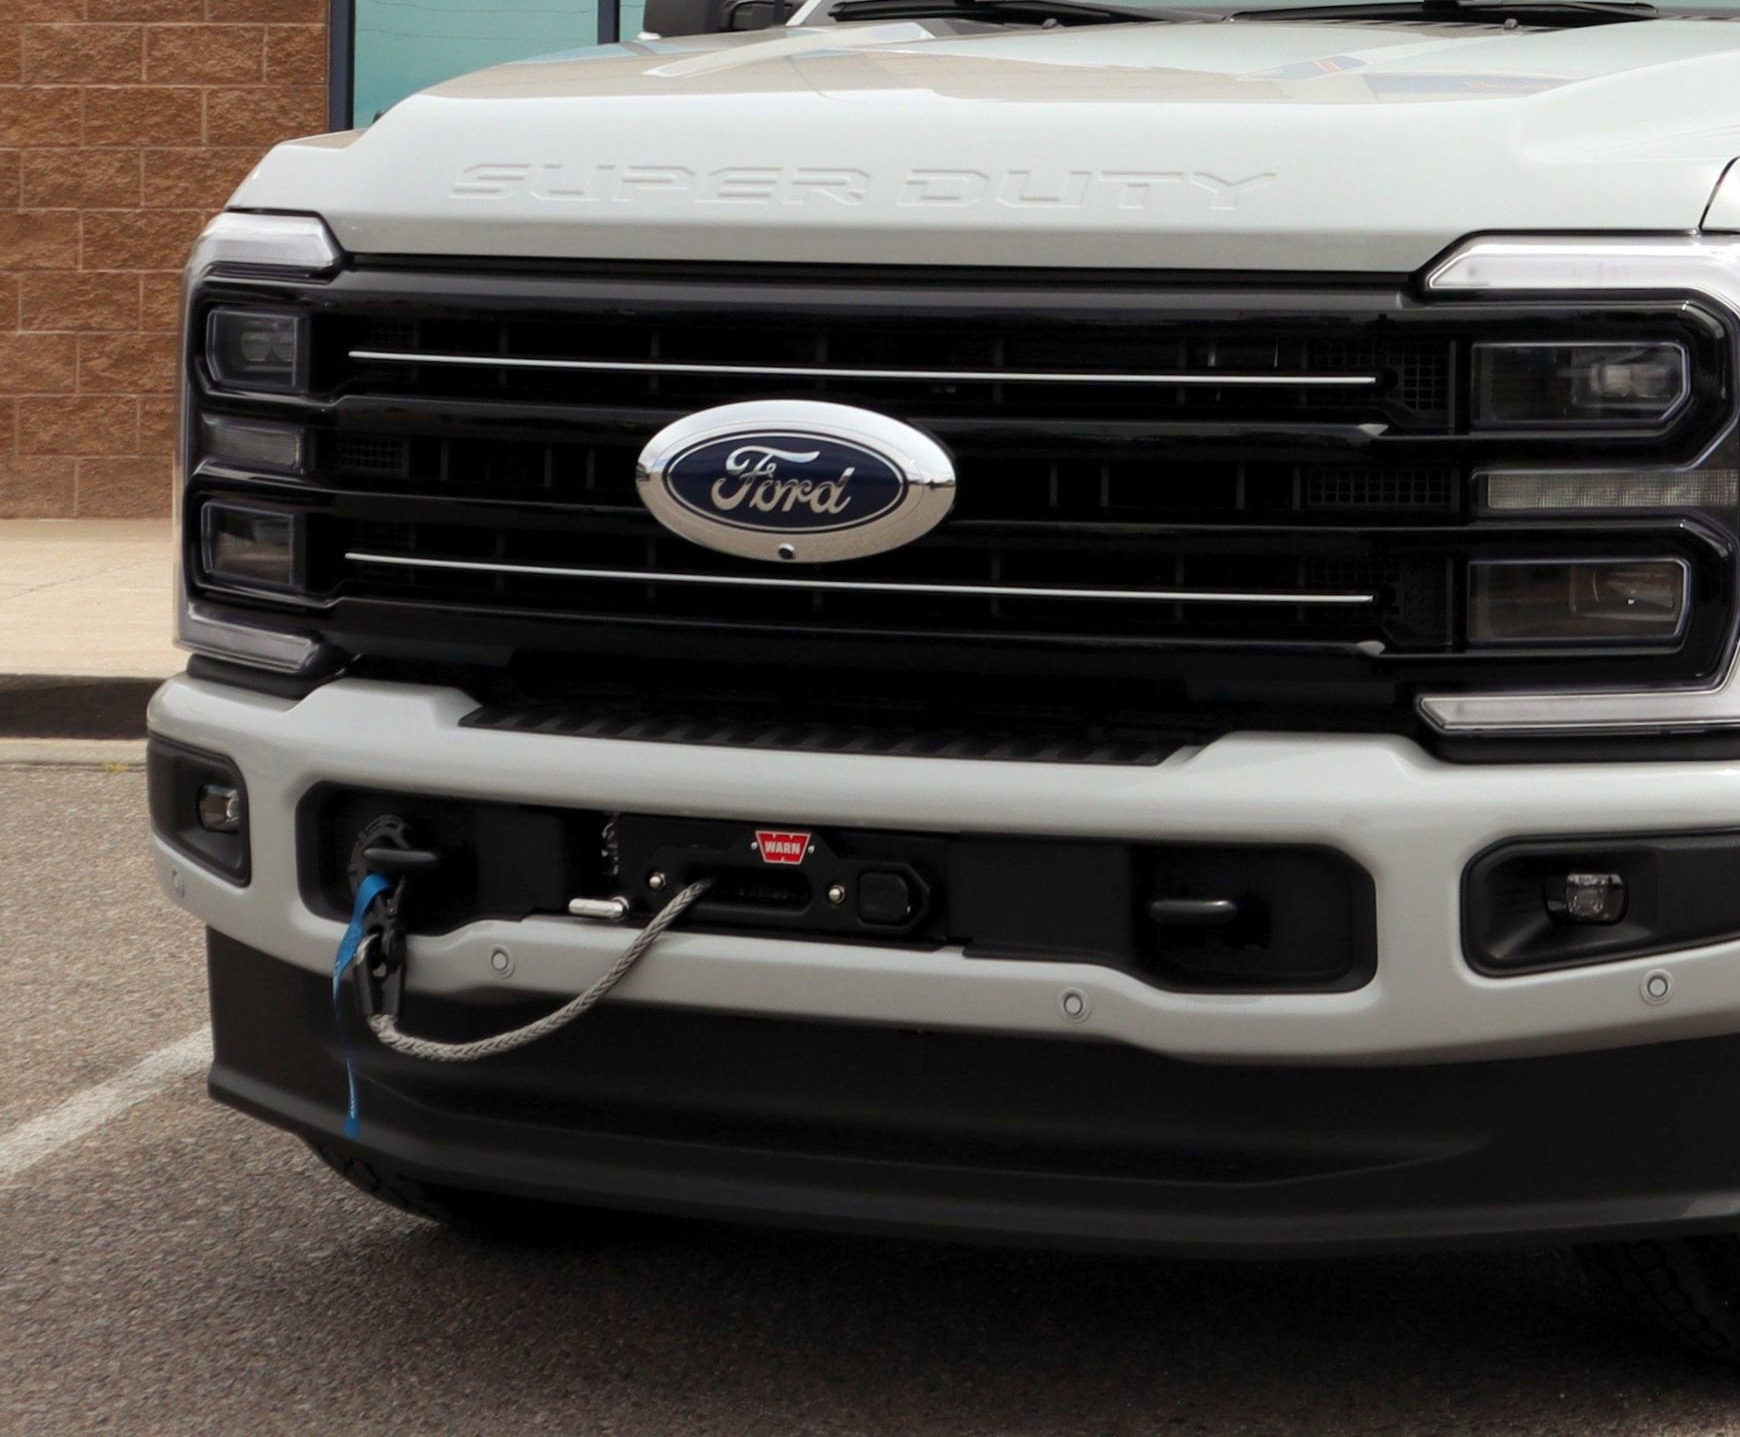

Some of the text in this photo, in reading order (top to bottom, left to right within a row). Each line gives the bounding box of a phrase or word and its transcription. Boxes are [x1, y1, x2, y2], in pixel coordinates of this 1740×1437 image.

[449, 163, 1278, 211] SUPER DUTY
[711, 444, 857, 516] Ford
[764, 840, 801, 855] WARN
